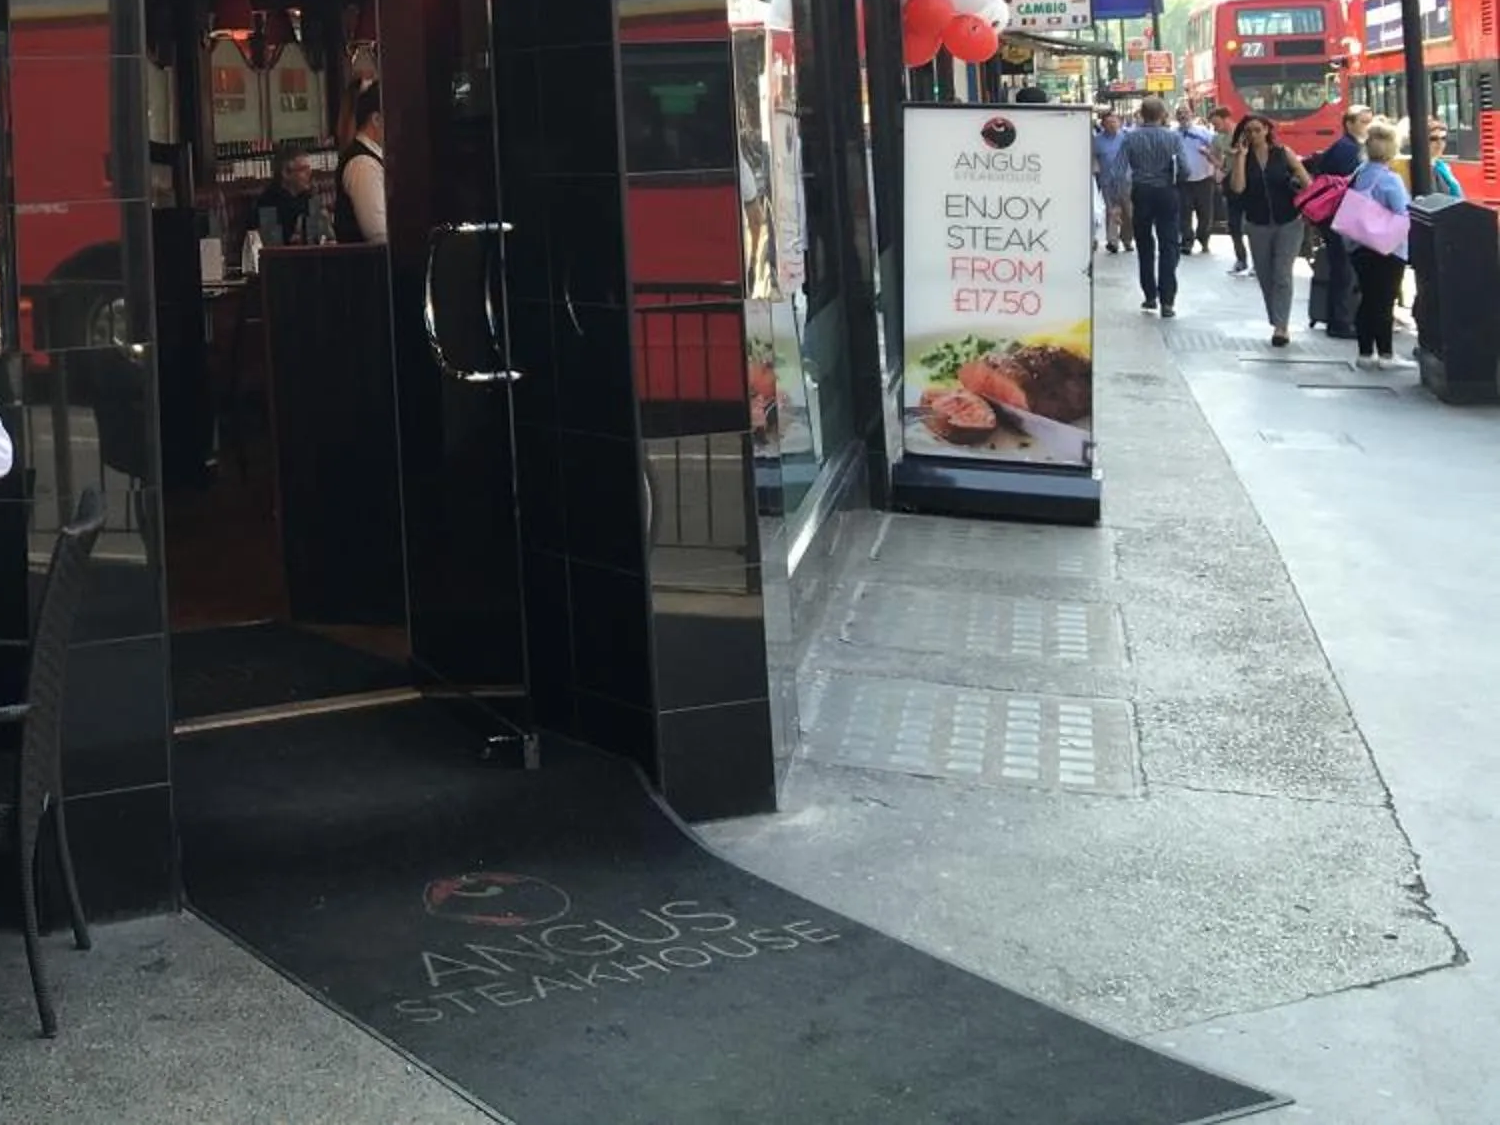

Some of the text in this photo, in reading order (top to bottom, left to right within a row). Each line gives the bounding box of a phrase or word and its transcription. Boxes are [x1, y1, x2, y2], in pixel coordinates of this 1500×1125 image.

[1017, 2, 1067, 16] CAMBIO
[1241, 42, 1265, 58] 27
[954, 151, 1042, 172] ANGUS
[945, 194, 1051, 221] ENJOY
[946, 225, 1049, 253] STEAK
[950, 257, 1044, 284] FROM
[954, 290, 1042, 316] £17.50
[420, 900, 737, 987] ANGUS
[394, 919, 841, 1023] STEAKHOUSE
